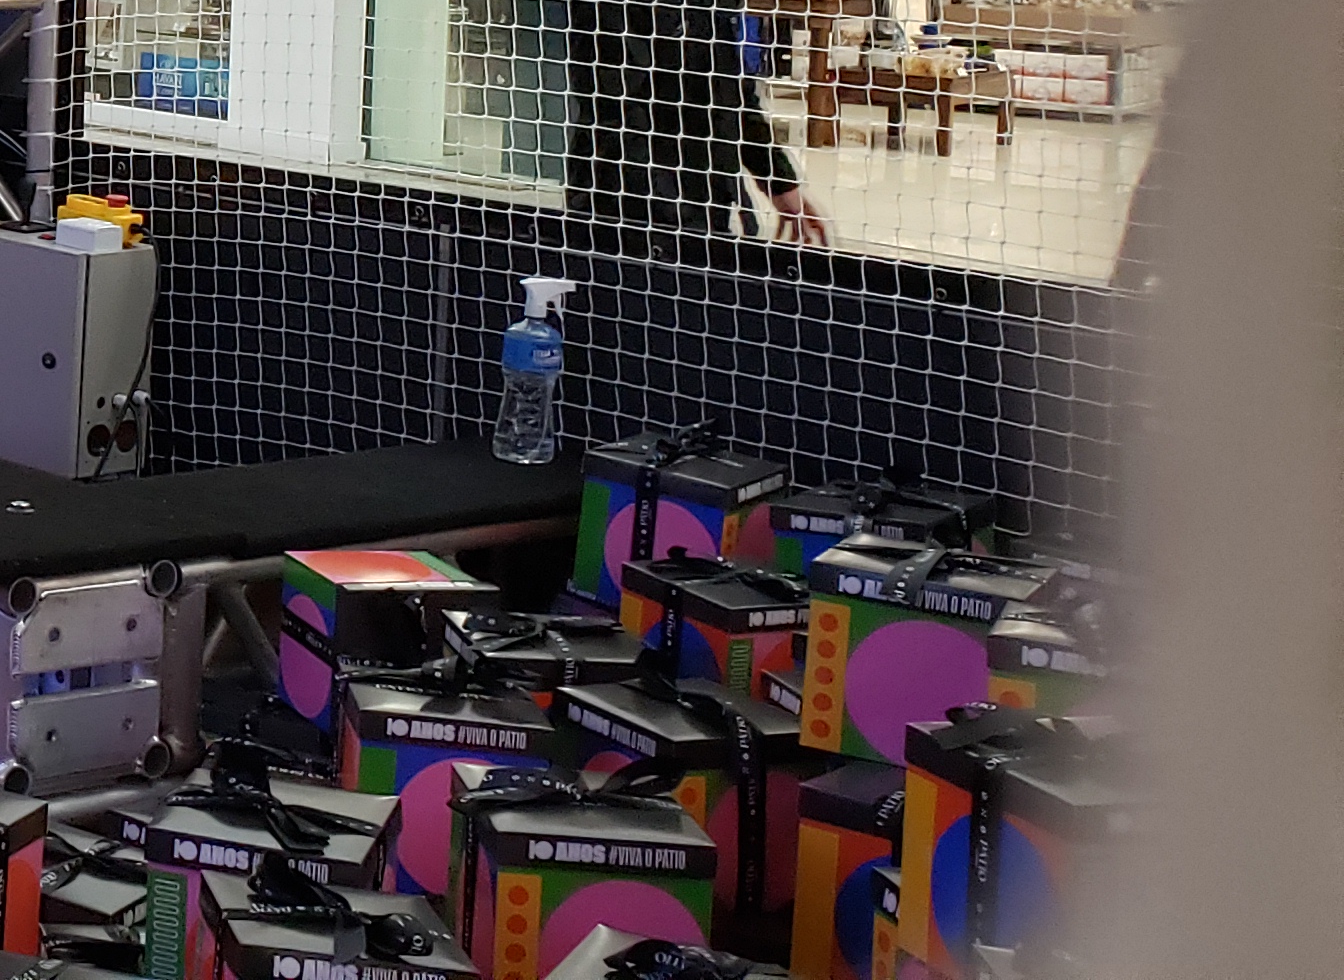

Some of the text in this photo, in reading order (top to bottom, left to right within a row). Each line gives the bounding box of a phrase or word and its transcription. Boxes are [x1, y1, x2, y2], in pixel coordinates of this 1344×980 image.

[790, 513, 845, 534] 10 ANOS
[838, 573, 862, 595] 10
[950, 596, 958, 613] O
[748, 610, 796, 627] 10 ANOS
[386, 717, 409, 736] 10
[410, 720, 456, 743] ANOS
[457, 726, 490, 748] #VIVA
[490, 730, 497, 748] O
[582, 706, 610, 738] ANOS
[174, 839, 249, 871] 10 ANOS
[528, 840, 686, 871] 10 ANOS #VIVA O PÁTIO
[273, 953, 302, 977] 10
